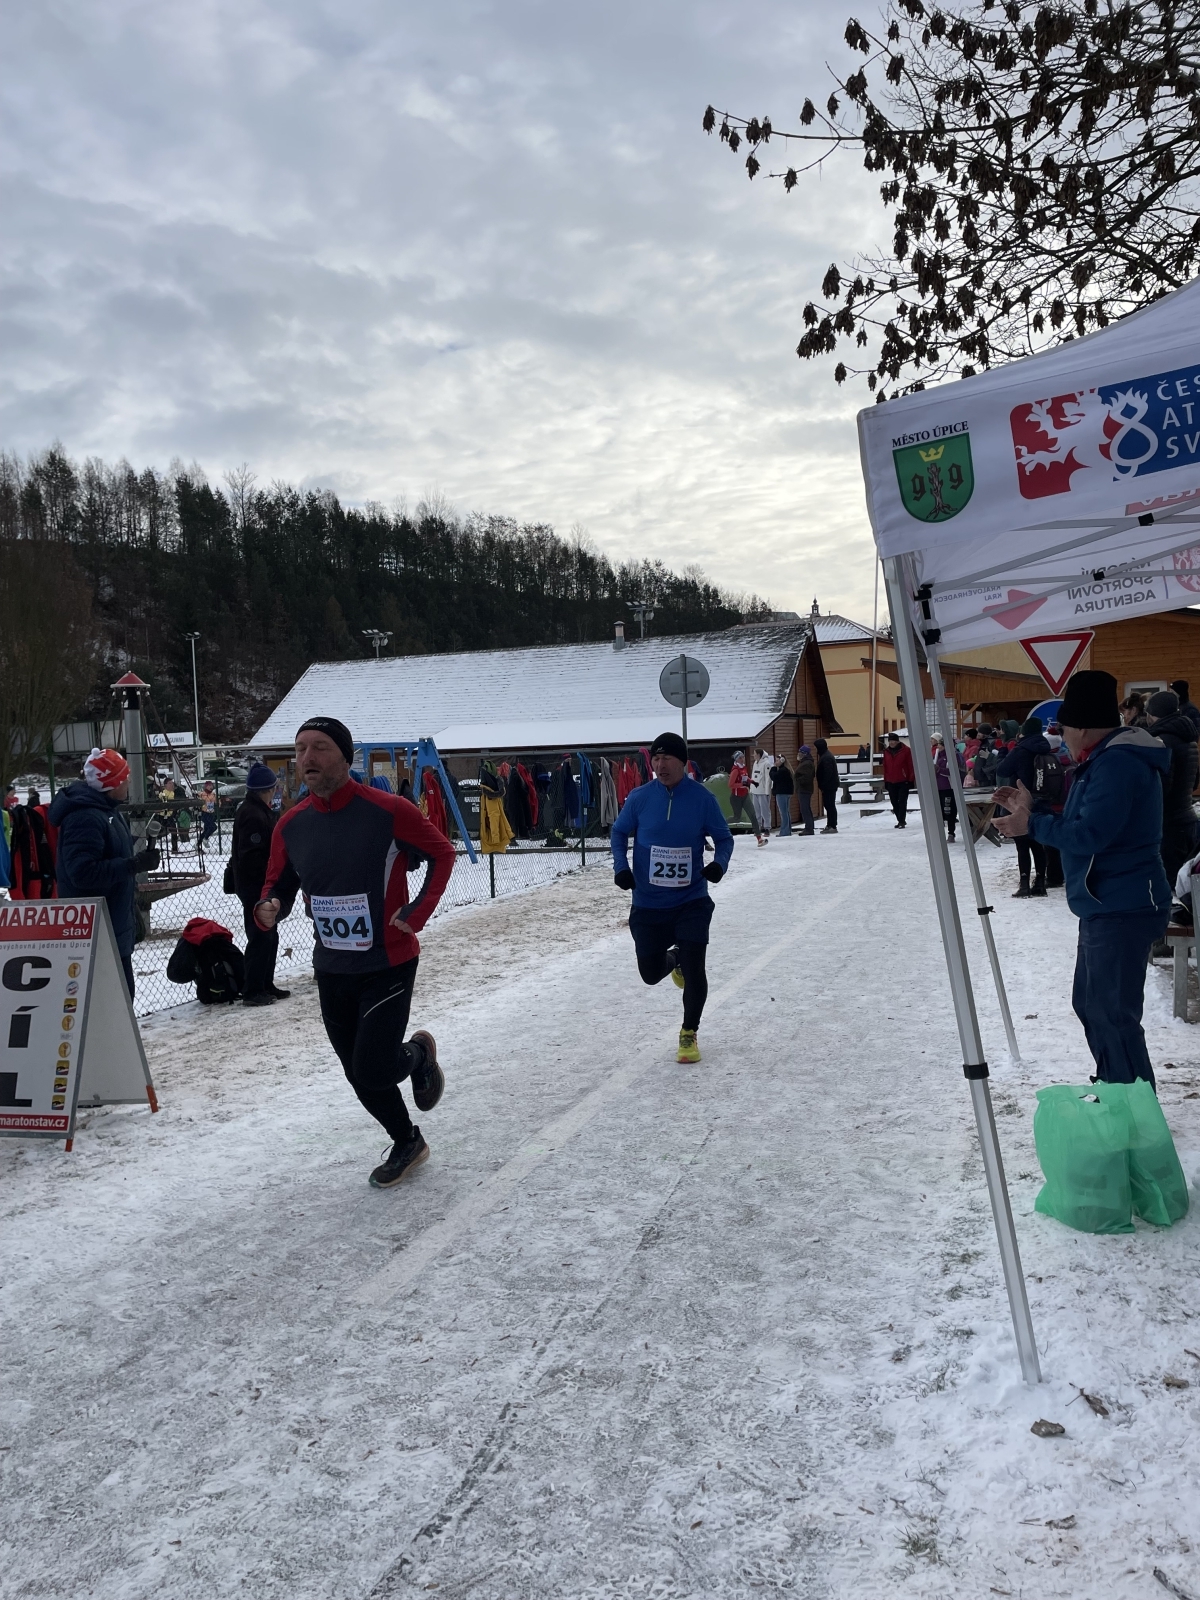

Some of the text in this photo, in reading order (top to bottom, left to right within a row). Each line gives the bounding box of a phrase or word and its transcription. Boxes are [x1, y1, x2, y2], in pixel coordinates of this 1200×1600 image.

[1162, 401, 1195, 430] AT
[891, 420, 969, 448] MĚSTO ÚPICE
[653, 862, 688, 878] 235
[62, 926, 89, 937] stav
[317, 916, 370, 938] 304
